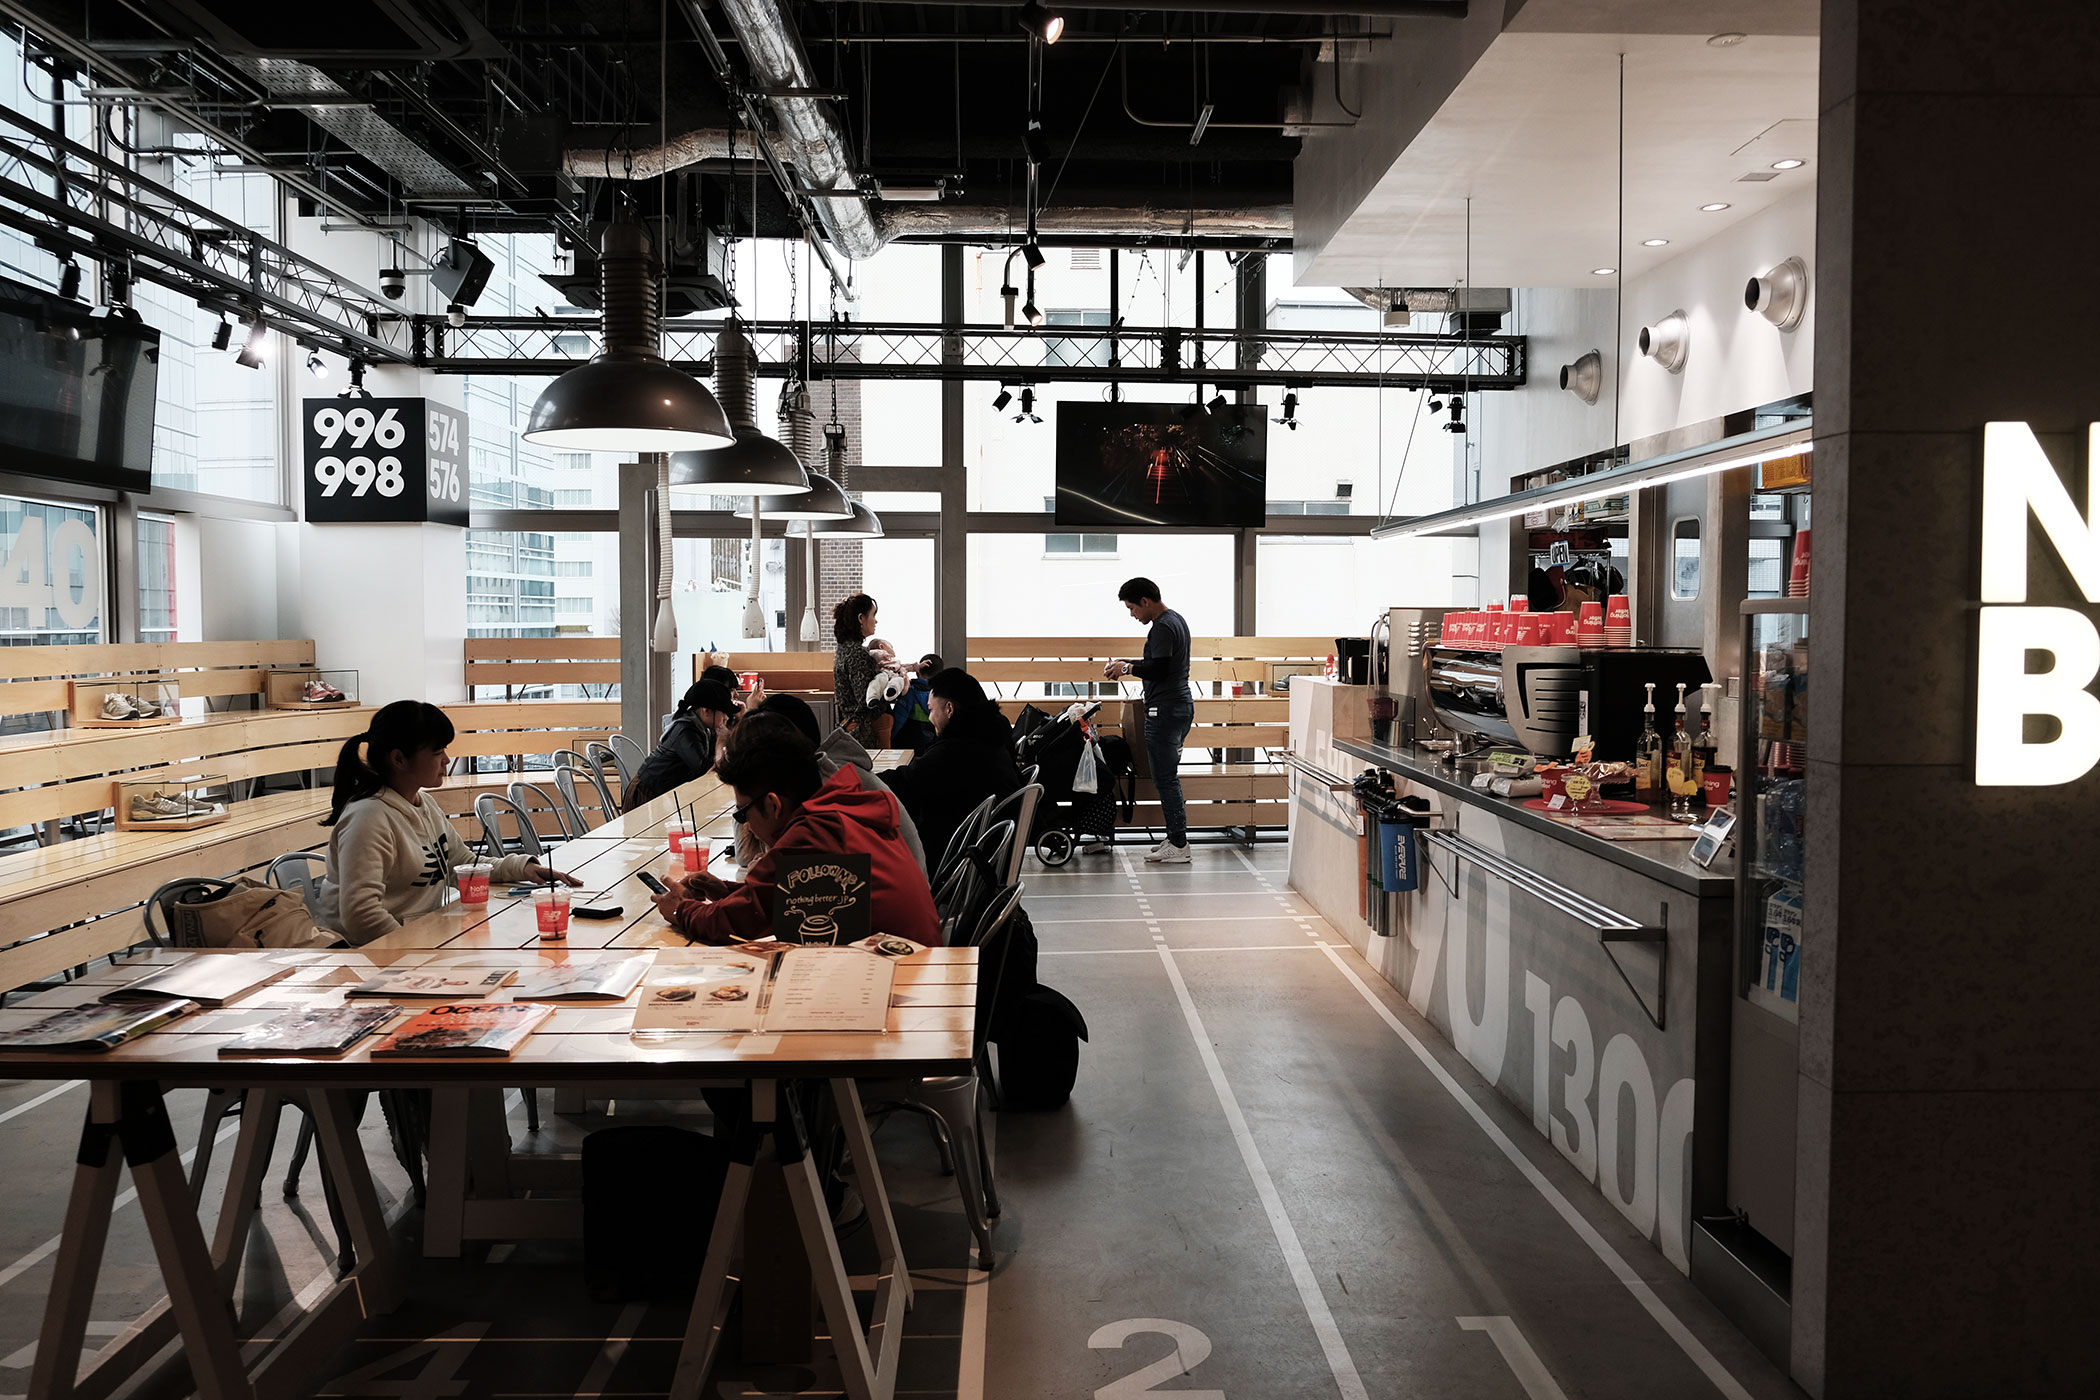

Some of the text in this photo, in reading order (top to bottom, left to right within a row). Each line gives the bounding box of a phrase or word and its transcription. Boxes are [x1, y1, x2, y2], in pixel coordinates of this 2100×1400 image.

[313, 407, 406, 449] 996
[428, 410, 460, 456] 574
[314, 455, 405, 497] 998
[429, 457, 461, 503] 576
[0, 516, 99, 629] 40
[1975, 606, 2100, 786] B
[1397, 834, 1407, 880] EVERPURE
[1366, 778, 1510, 1087] 90
[1525, 968, 1695, 1279] 1300
[1087, 1317, 1226, 1400] 2
